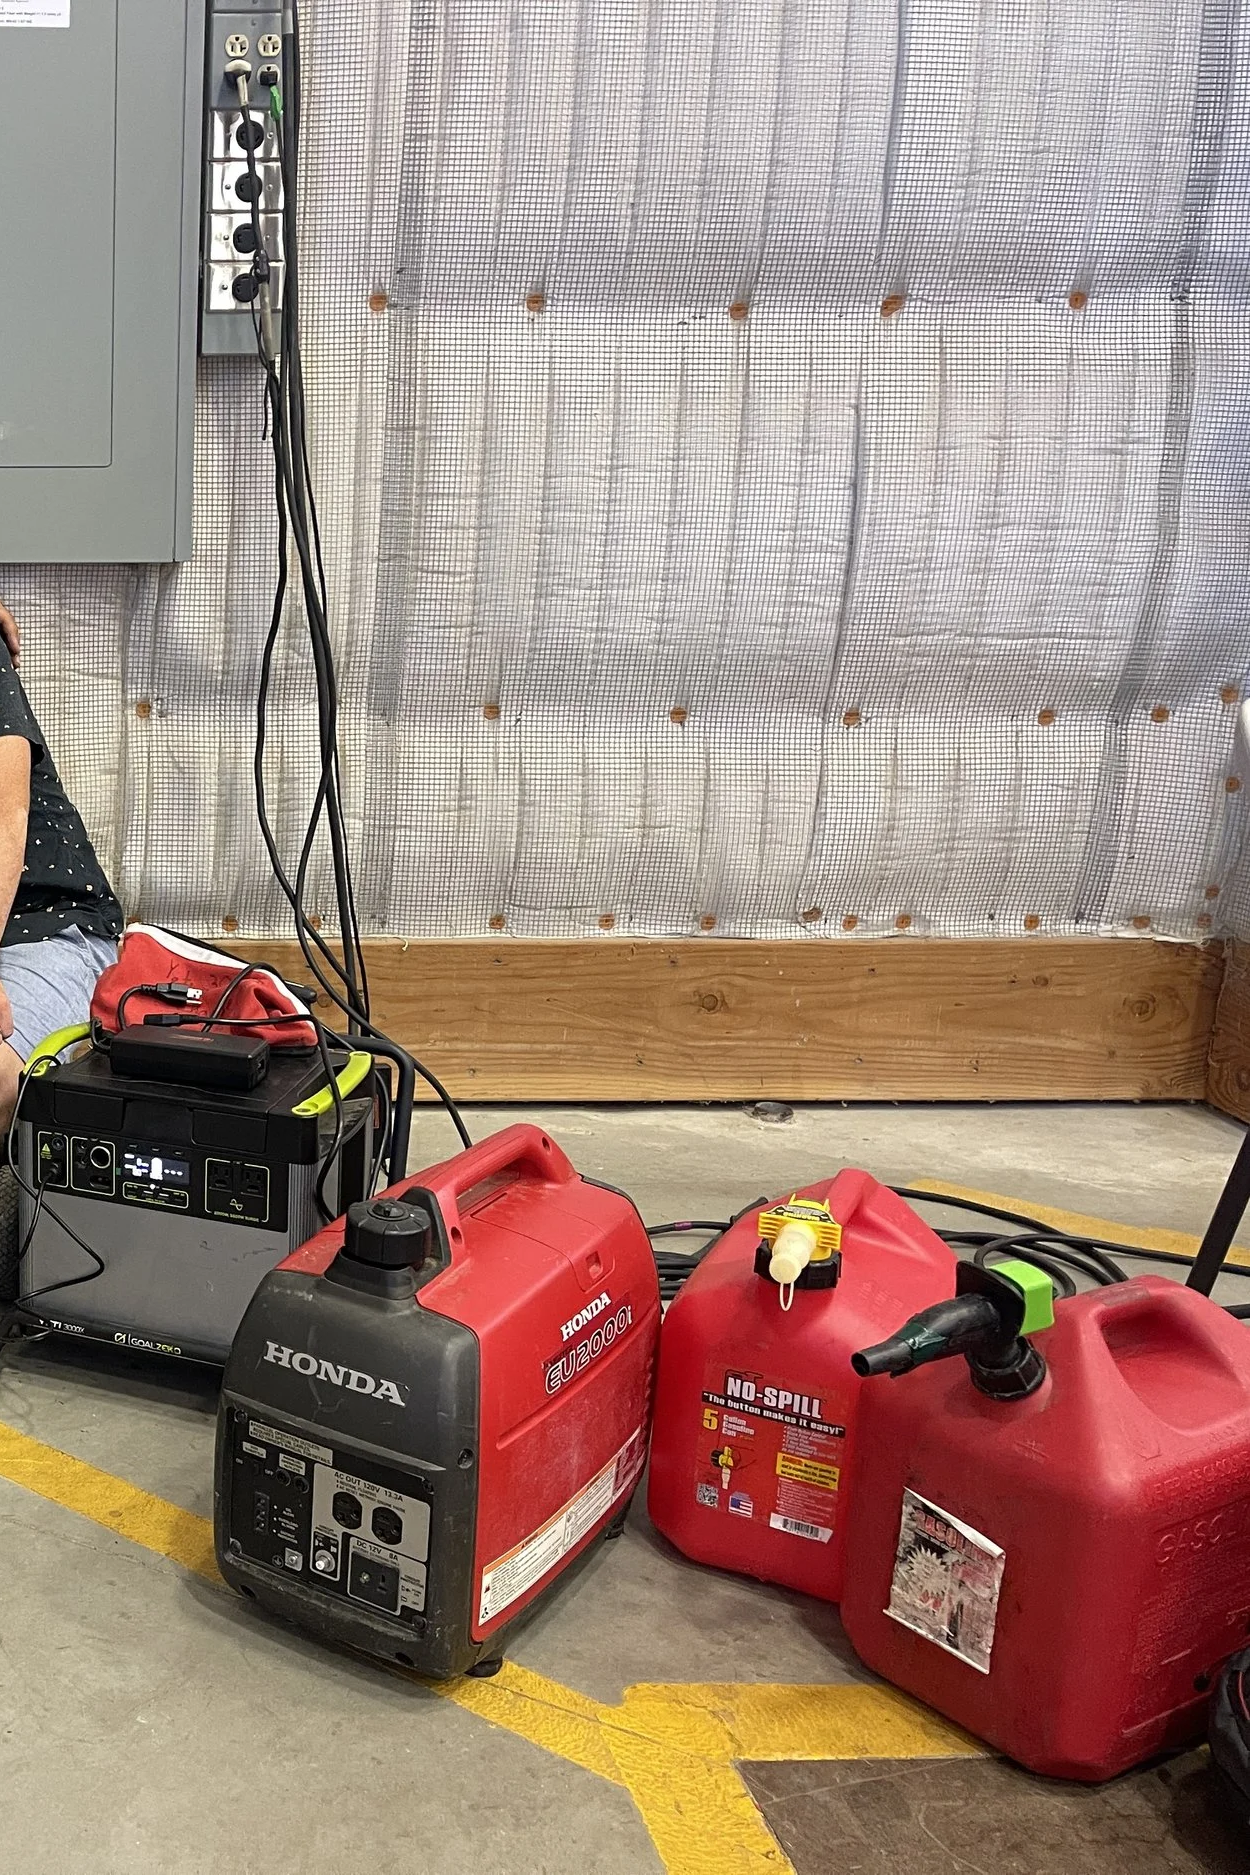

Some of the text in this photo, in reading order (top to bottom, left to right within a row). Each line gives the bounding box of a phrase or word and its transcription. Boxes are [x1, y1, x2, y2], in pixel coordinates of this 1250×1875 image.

[63, 1323, 85, 1334] 3000X
[560, 1292, 612, 1342] HONDA
[545, 1305, 633, 1394] EU2000i
[263, 1340, 406, 1407] HONDA
[726, 1376, 822, 1419] NO-SPILL
[702, 1408, 718, 1431] 5
[727, 1398, 760, 1415] button
[763, 1408, 796, 1424] makes
[798, 1417, 807, 1427] it
[721, 1427, 737, 1437] Can
[334, 1471, 344, 1480] AC
[345, 1475, 361, 1486] OUT
[363, 1481, 381, 1493] 120V
[356, 1539, 367, 1549] DC
[368, 1544, 383, 1555] 12V
